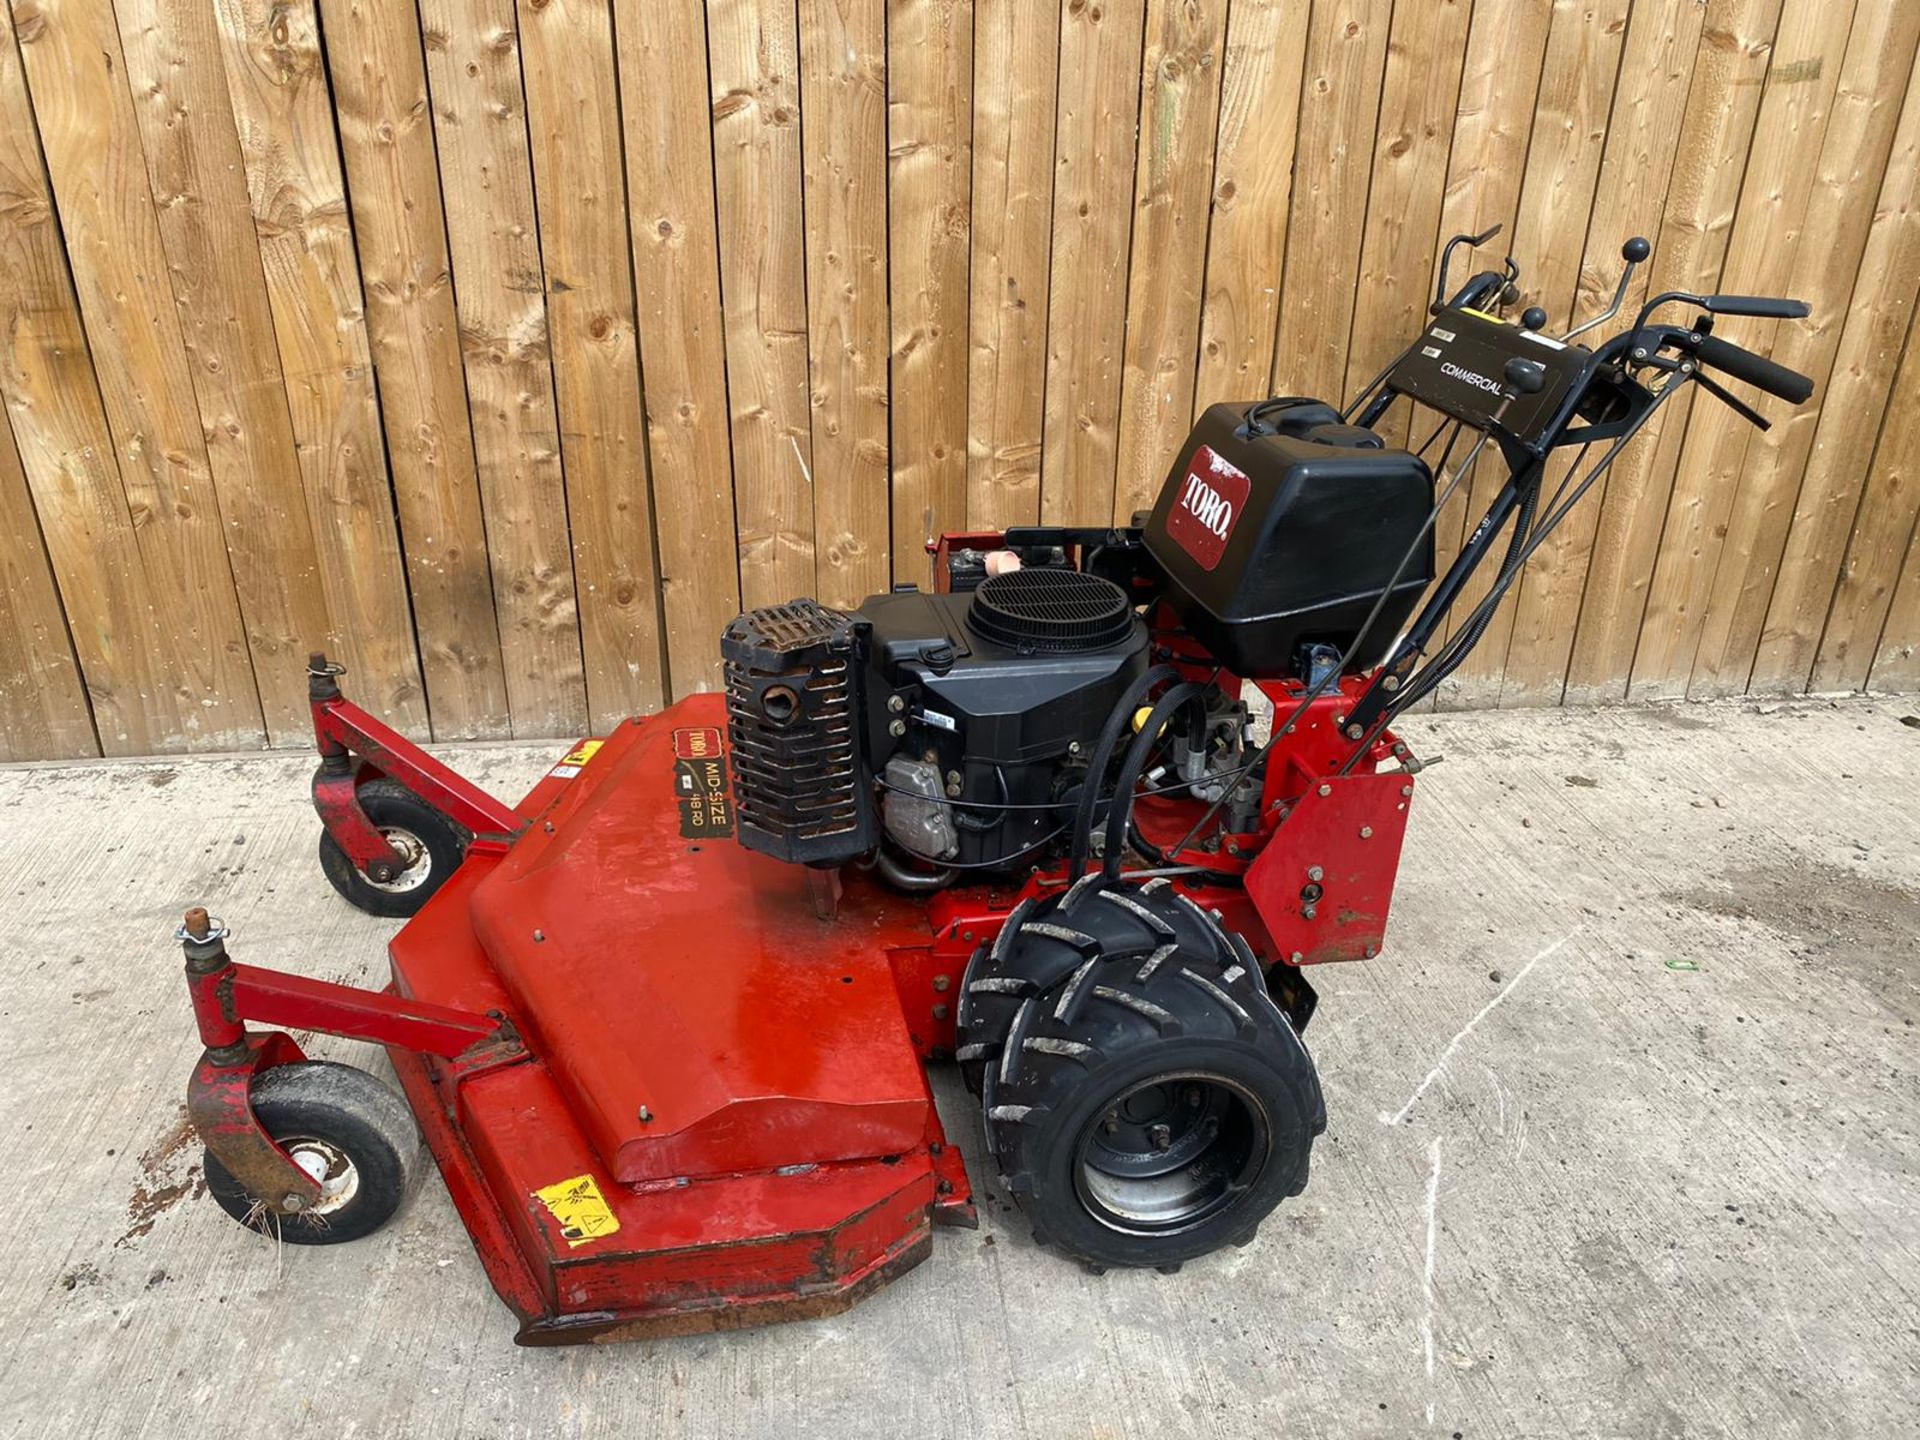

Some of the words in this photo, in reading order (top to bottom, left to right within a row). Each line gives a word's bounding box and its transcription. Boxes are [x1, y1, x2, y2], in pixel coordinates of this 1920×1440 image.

[1440, 362, 1502, 395] COMMERCIAL
[1181, 472, 1232, 536] TORO
[689, 731, 707, 756] TORO
[692, 811, 704, 827] RD
